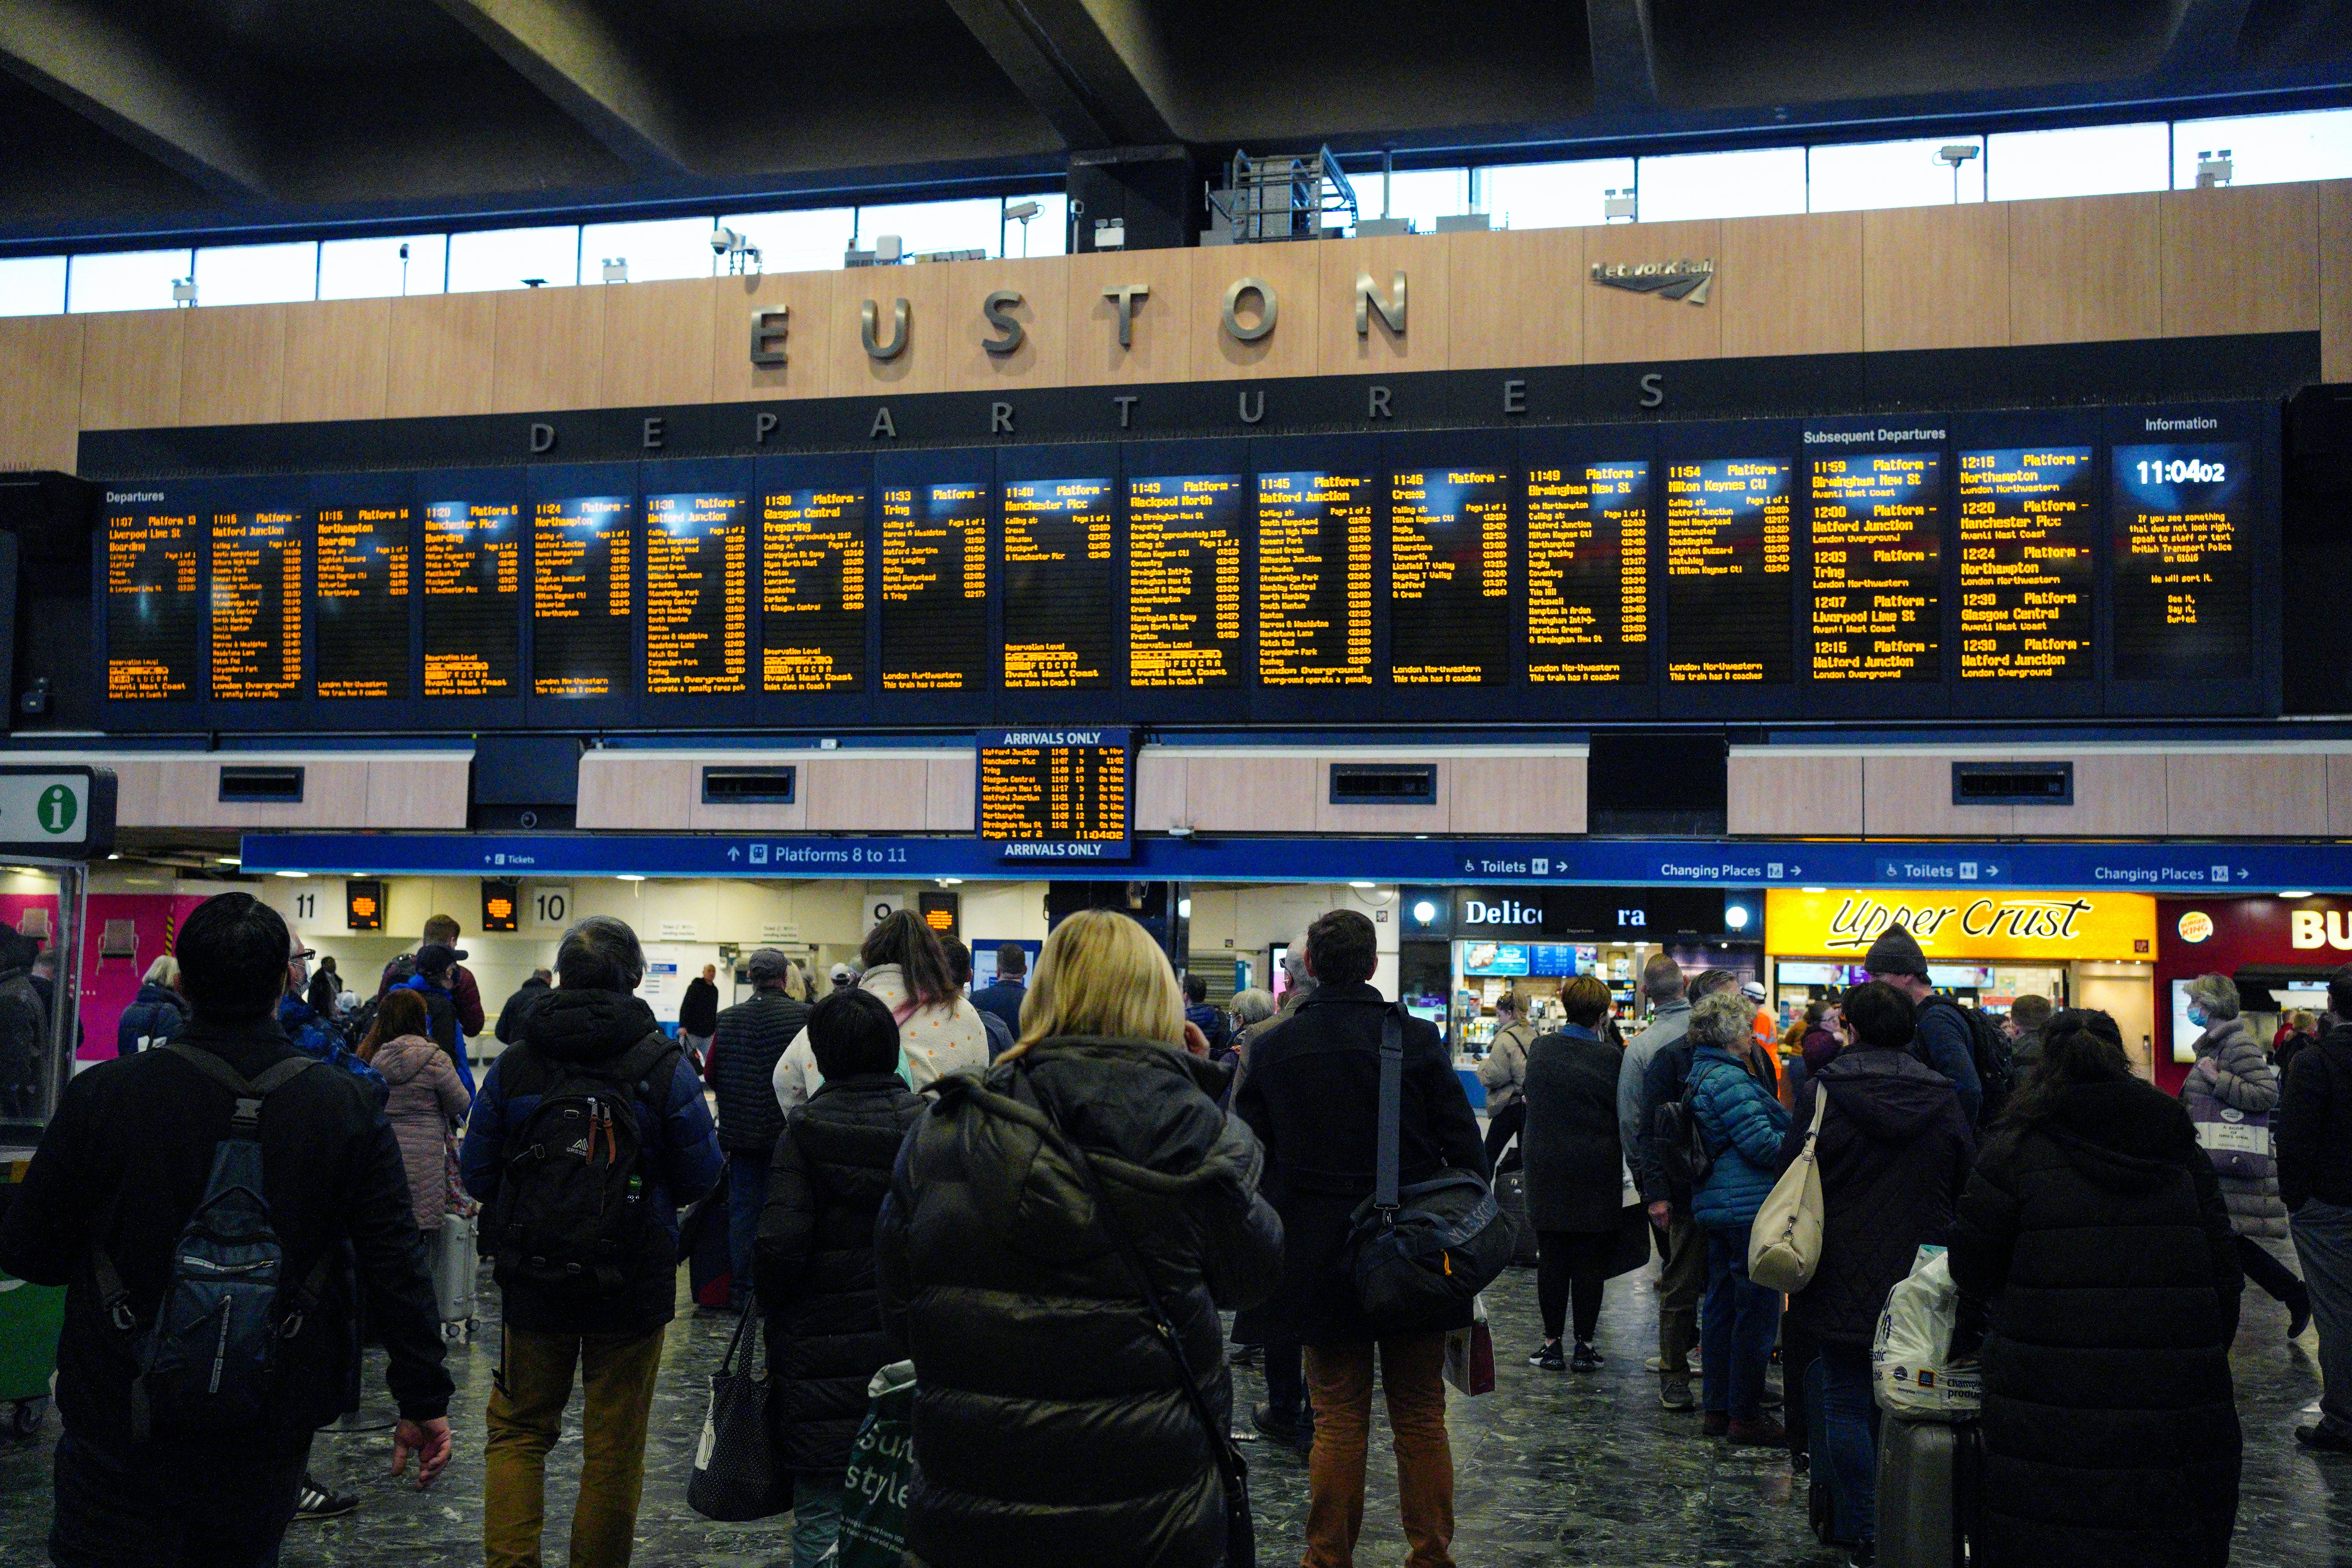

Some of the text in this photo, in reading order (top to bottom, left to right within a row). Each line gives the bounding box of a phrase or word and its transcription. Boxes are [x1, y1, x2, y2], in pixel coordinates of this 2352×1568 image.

[749, 270, 1407, 365] EUSTON
[529, 372, 1665, 455] DEPARTURES
[2146, 418, 2217, 431] Information
[1804, 429, 1945, 445] Subsequent Departures
[1815, 460, 1924, 473] 11:59 Platform
[1962, 455, 2075, 468] 12:15 Platform
[1530, 469, 1633, 481] 11:49 Platform
[1670, 465, 1777, 477] 11:54 Platform
[1961, 471, 2038, 483] Northampton
[1262, 477, 1359, 488] 11:45 Platform
[1394, 473, 1495, 485] 11:46 Platform
[1813, 474, 1921, 488] Birmingham New St
[1057, 486, 1100, 495] Platform
[1133, 481, 1228, 493] 11:43 Platform
[1529, 483, 1630, 496] Birmingham New St
[1669, 481, 1700, 492] Milton
[1705, 481, 1745, 492] Keynes
[107, 491, 164, 504] Departures
[766, 494, 854, 505] 11:30 Platform
[885, 490, 975, 501] 11:33 Platform
[1260, 491, 1350, 503] Watford Junction
[1392, 490, 1425, 499] Crewe
[650, 499, 735, 510] 11:30 Platform
[1005, 499, 1087, 511] Manchester Picc
[1131, 495, 1212, 507] Blackpool North
[1963, 500, 2076, 514] 12:20 Platform
[471, 506, 508, 516] Platform
[537, 503, 620, 514] 11:24 Platform
[764, 507, 840, 520] Glasgow Central
[884, 505, 909, 515] Tring
[1815, 505, 1924, 518] 12:00 Platform
[111, 515, 196, 526] 11:07 Platform 13
[256, 514, 292, 523] Platform
[359, 510, 395, 520] Platform
[648, 512, 726, 523] Watford Junction
[426, 519, 497, 530] Manchester Picc
[535, 517, 593, 526] Northampton
[764, 522, 811, 533] Preparing
[1813, 519, 1913, 533] Watford Junction
[1961, 515, 2061, 529] Manchester Picc
[110, 528, 180, 539] Liverpool Lime St
[213, 526, 284, 537] Watford Junction
[318, 524, 373, 534] Northampton
[318, 536, 356, 546] Boarding
[425, 534, 463, 545] Boarding
[1964, 546, 2076, 560] 12:24 Platform
[2162, 544, 2204, 554] Transport
[1874, 550, 1924, 561] Platform
[1814, 566, 1845, 579] Tring
[1961, 563, 2039, 575] Northampton
[1815, 595, 1924, 608] 12:07 Platform
[1964, 592, 2076, 605] 12:30 Platform
[1813, 610, 1915, 624] Liverpool Lime St
[1962, 608, 2058, 622] Glasgow Central
[1815, 641, 1925, 653] 12:15 Platform
[1964, 639, 2077, 651] 12:30 Platform
[1814, 656, 1913, 668] Watford Junction
[1962, 654, 2065, 666] Watford Junction
[1004, 733, 1101, 744] ARRIVALS ONLY
[983, 830, 1007, 838] Page
[1076, 831, 1123, 839] 11:04:02
[776, 847, 906, 862] Platforms 8 to 11
[1005, 844, 1102, 855] ARRIVALS ONLY
[508, 855, 534, 864] Tickets
[1481, 860, 1526, 873] Toilets
[1661, 864, 1761, 878] Changing Places
[1905, 864, 1953, 877] Toilets
[2095, 868, 2204, 882] Changing Places
[297, 894, 314, 918] 11
[537, 895, 564, 920] 10
[1466, 901, 1542, 924] Delic
[1827, 898, 2093, 947] Upper Crust
[2182, 925, 2208, 936] KING
[566, 1147, 588, 1156] GREGO
[845, 1466, 909, 1509] style
